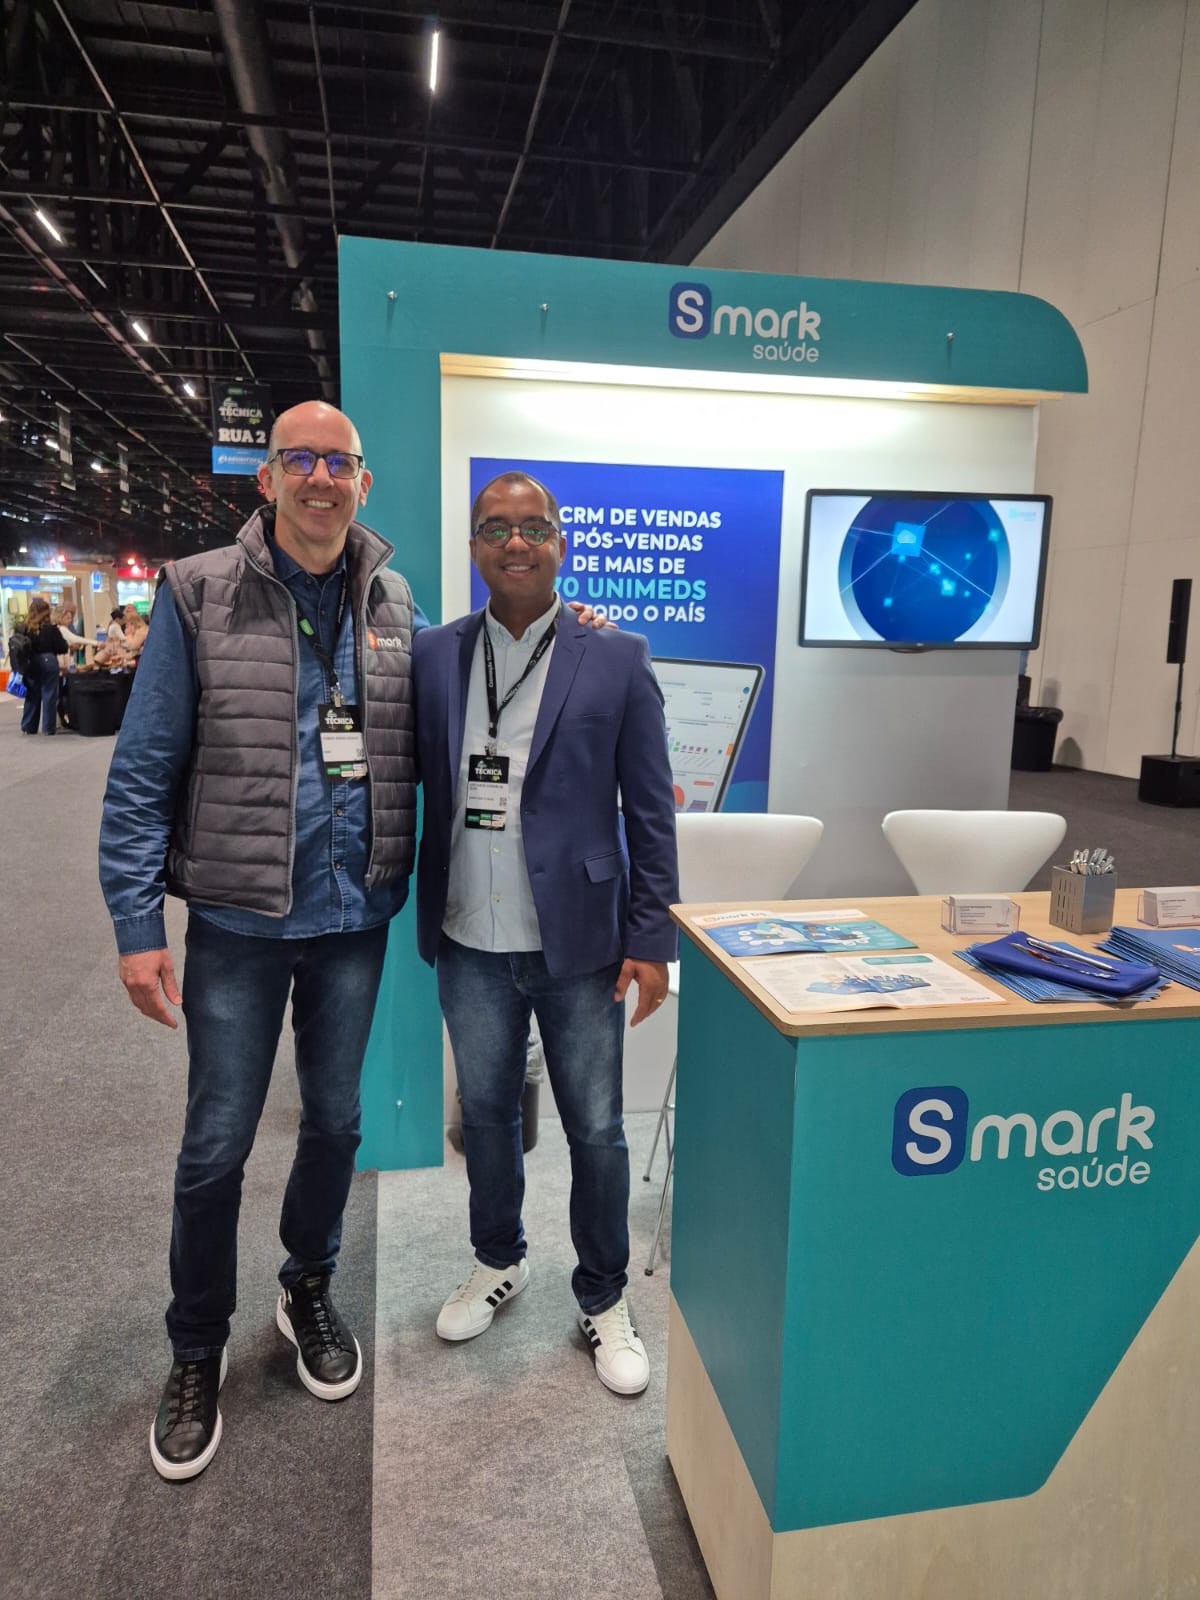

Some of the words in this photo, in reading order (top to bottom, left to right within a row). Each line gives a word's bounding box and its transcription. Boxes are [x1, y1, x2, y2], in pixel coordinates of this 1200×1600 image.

[676, 290, 821, 341] Smark
[752, 341, 820, 363] saúde
[218, 428, 254, 443] RUA
[255, 430, 266, 443] 2
[559, 506, 604, 525] CRM
[610, 508, 637, 526] DE
[641, 509, 722, 529] VENDAS
[573, 527, 703, 552] PÓS-VENDAS
[572, 555, 600, 573] DE
[605, 556, 654, 574] MAIS
[659, 558, 686, 575] DE
[587, 577, 707, 601] UNIMEDS
[590, 603, 638, 622] ODO
[643, 605, 659, 622] O
[664, 602, 706, 623] PAÍS
[906, 1093, 1155, 1165] Smark
[1037, 1155, 1151, 1191] saúde
